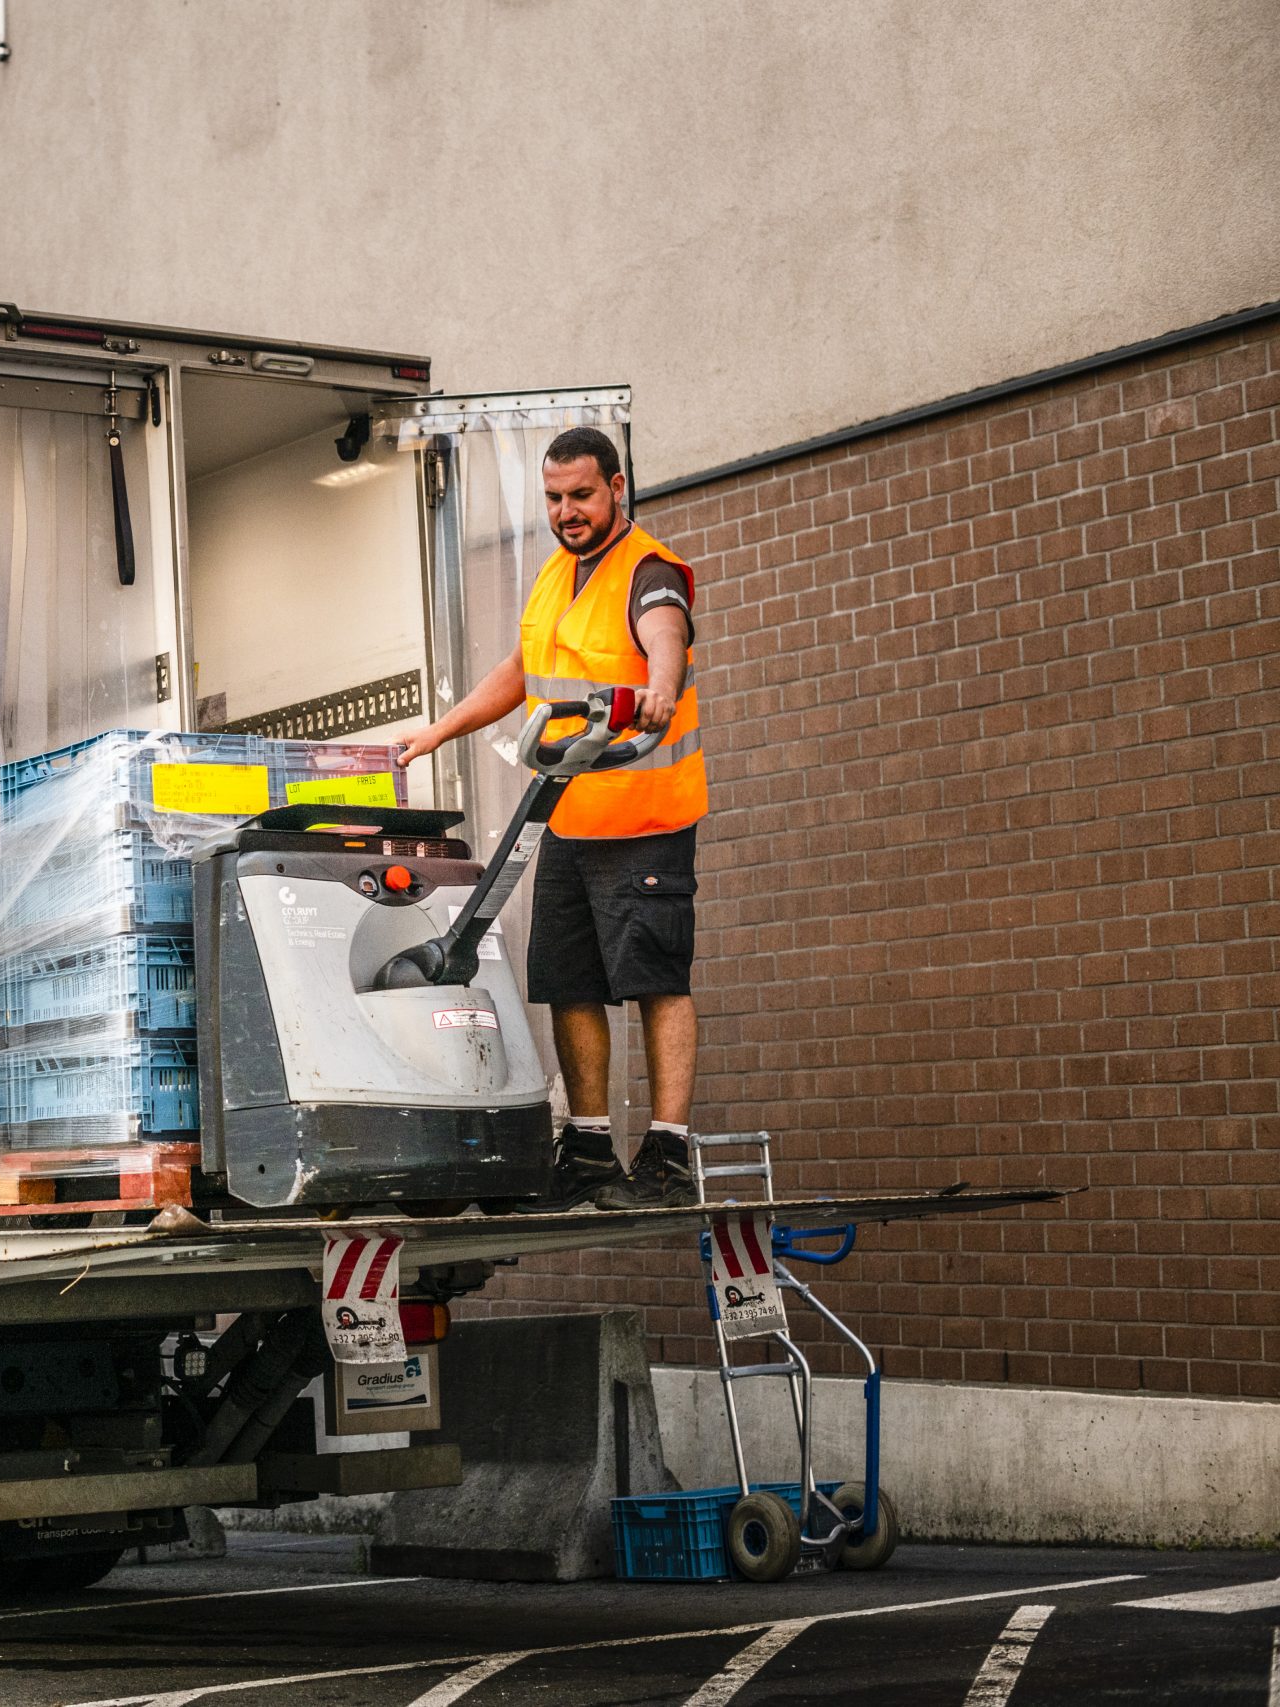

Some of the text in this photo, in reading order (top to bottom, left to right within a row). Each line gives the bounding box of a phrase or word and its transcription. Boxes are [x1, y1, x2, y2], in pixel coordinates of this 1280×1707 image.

[356, 775, 377, 786] FRAIS
[288, 784, 301, 794] LOT
[283, 916, 310, 925] GOUP
[333, 1334, 349, 1344] +32
[350, 1334, 357, 1343] 2
[358, 1373, 404, 1386] Gradius
[37, 1528, 80, 1540] transport
